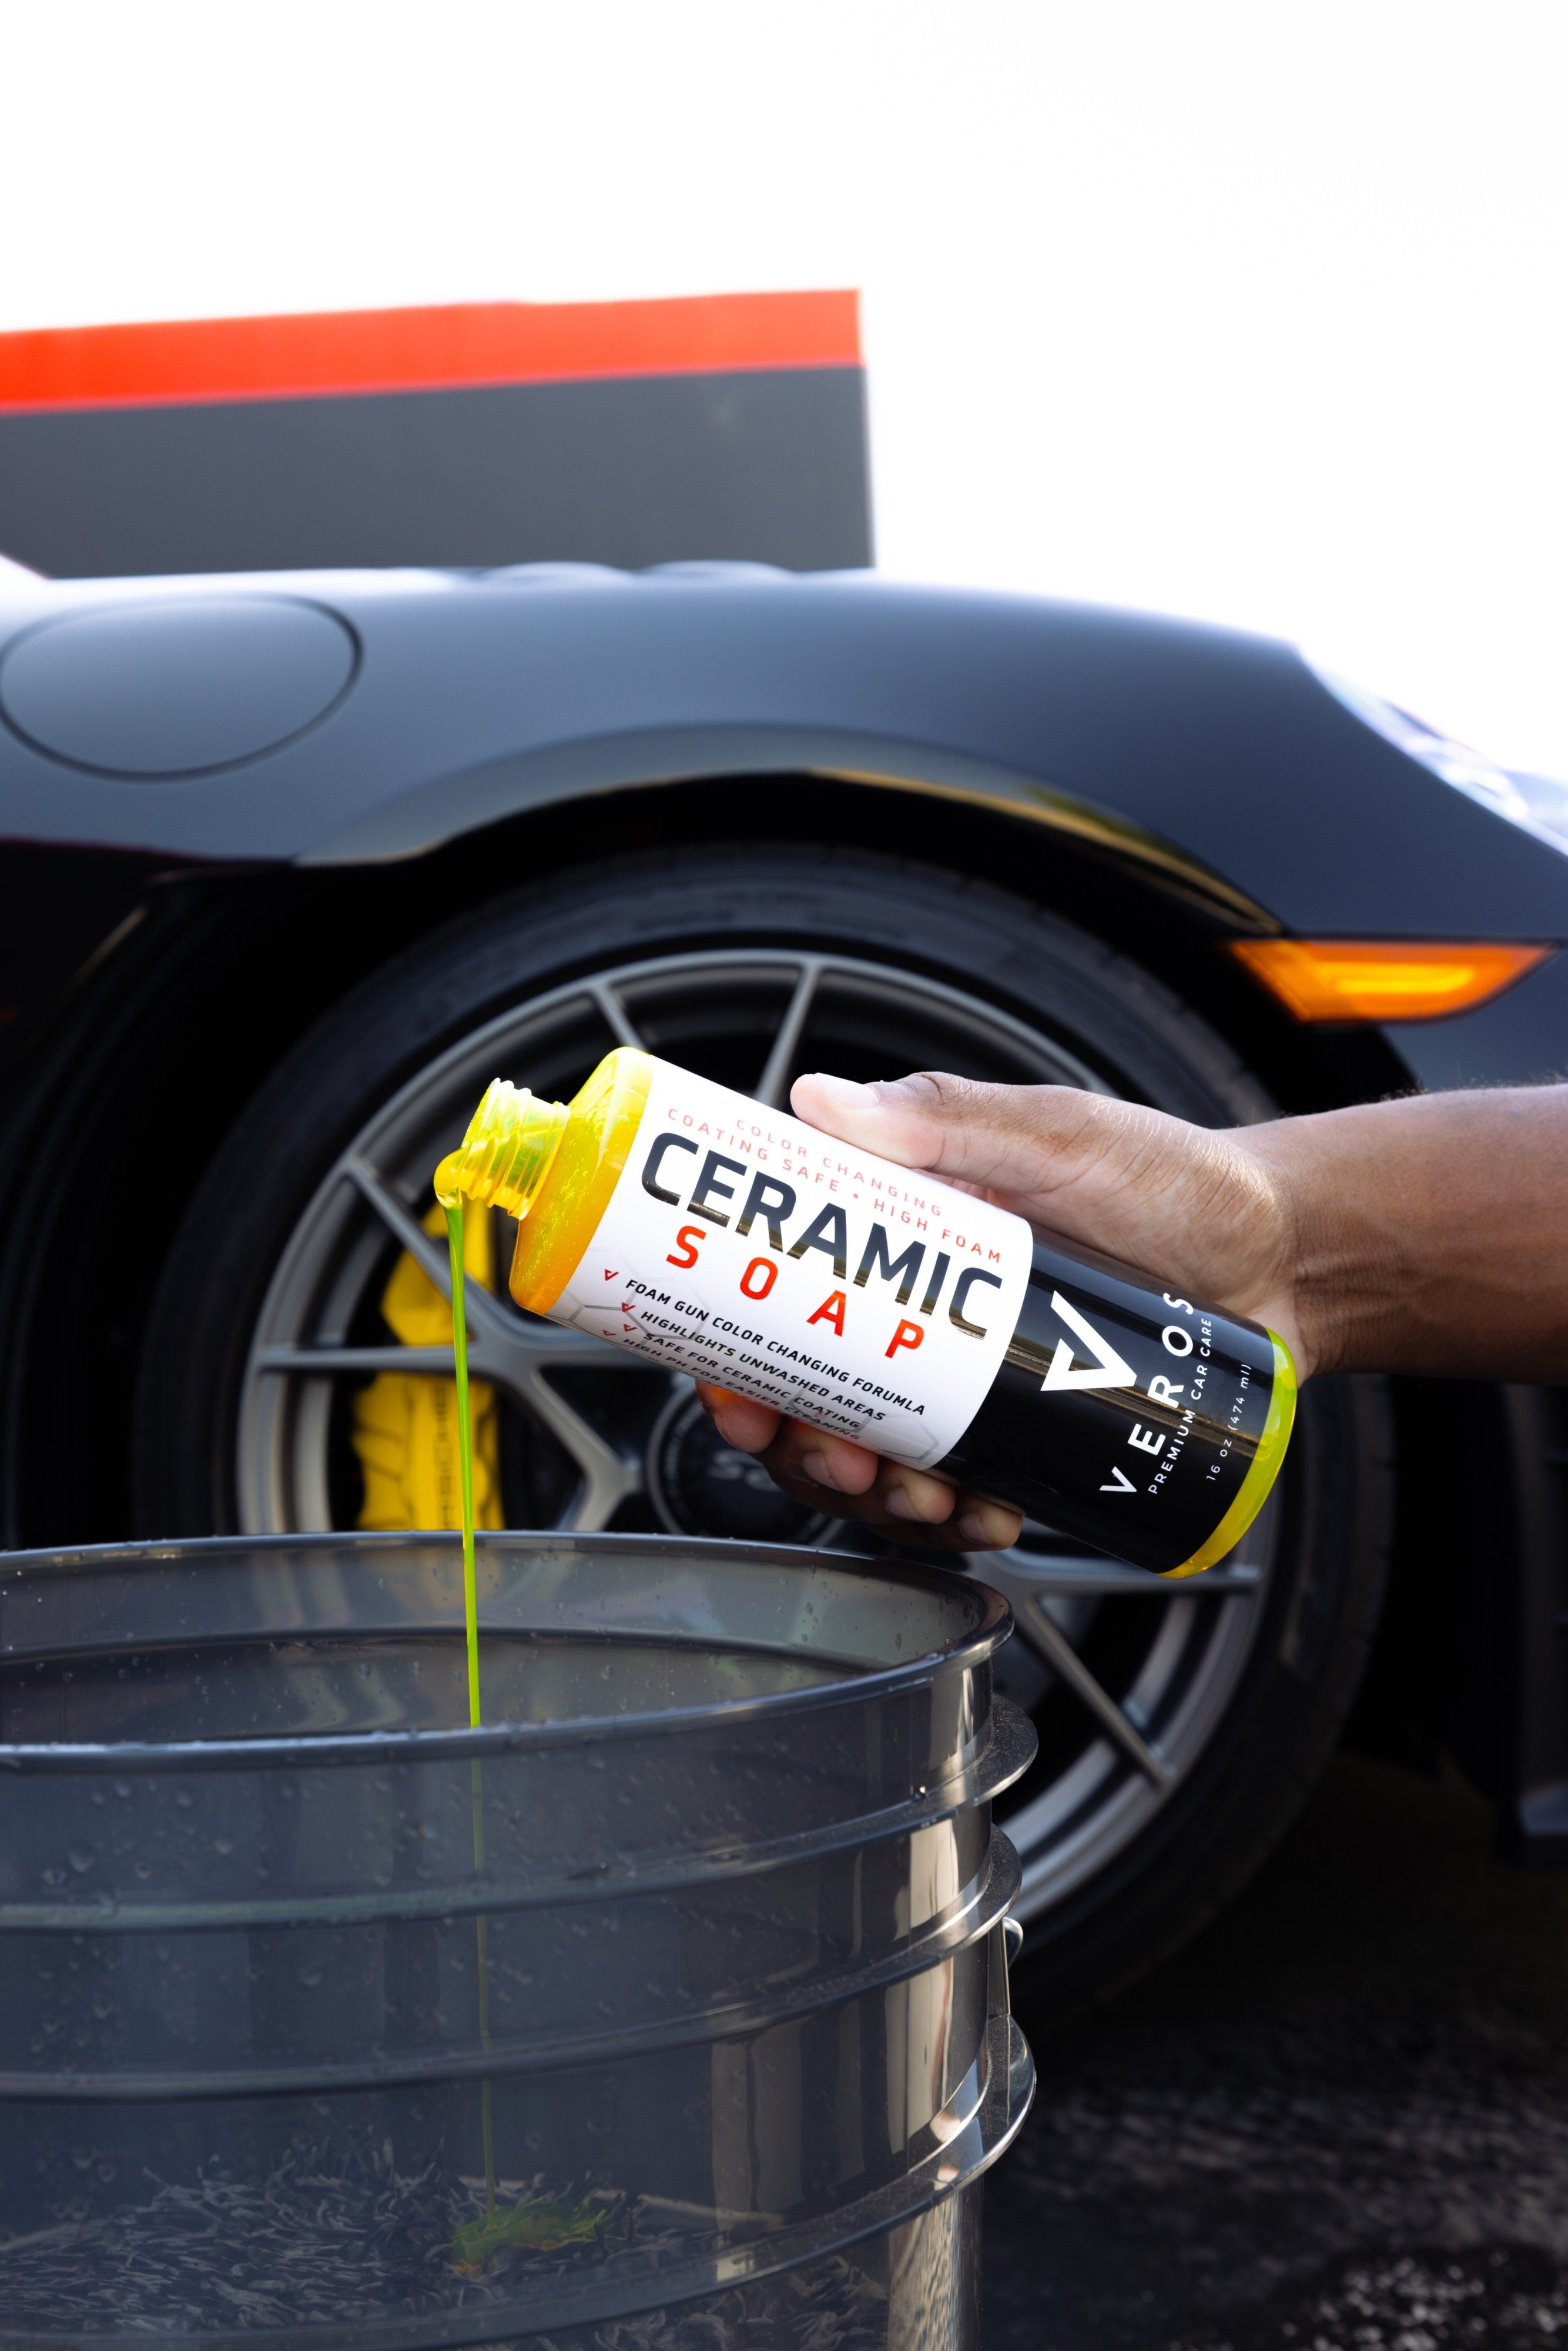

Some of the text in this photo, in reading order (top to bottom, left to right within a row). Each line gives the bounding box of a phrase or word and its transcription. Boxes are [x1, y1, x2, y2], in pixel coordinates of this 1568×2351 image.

[668, 1108, 1000, 1262] COATING SAFE HIGH FOAM
[736, 1120, 941, 1216] COLOR CHANGING
[641, 1133, 1003, 1341] CERAMIC
[666, 1225, 924, 1358] SOAP
[622, 1338, 861, 1440] HIGH PH FOR EASIER CLEANING
[625, 1280, 925, 1415] FOAM GUN COLOR CHANGING FORUMLA
[641, 1311, 736, 1357] HIGHLIGHTS
[739, 1353, 830, 1396] UNWASHED
[831, 1395, 886, 1421] AREAS
[644, 1333, 685, 1353] SAFE
[688, 1351, 719, 1368] FOR
[722, 1367, 792, 1398] CERAMIC
[793, 1397, 860, 1428] COATING
[1099, 1292, 1194, 1493] VEROS
[1148, 1318, 1212, 1494] PREMIUM CAR CARE
[1207, 1465, 1221, 1481] 16
[1220, 1439, 1232, 1457] oz
[1228, 1397, 1245, 1431] (474
